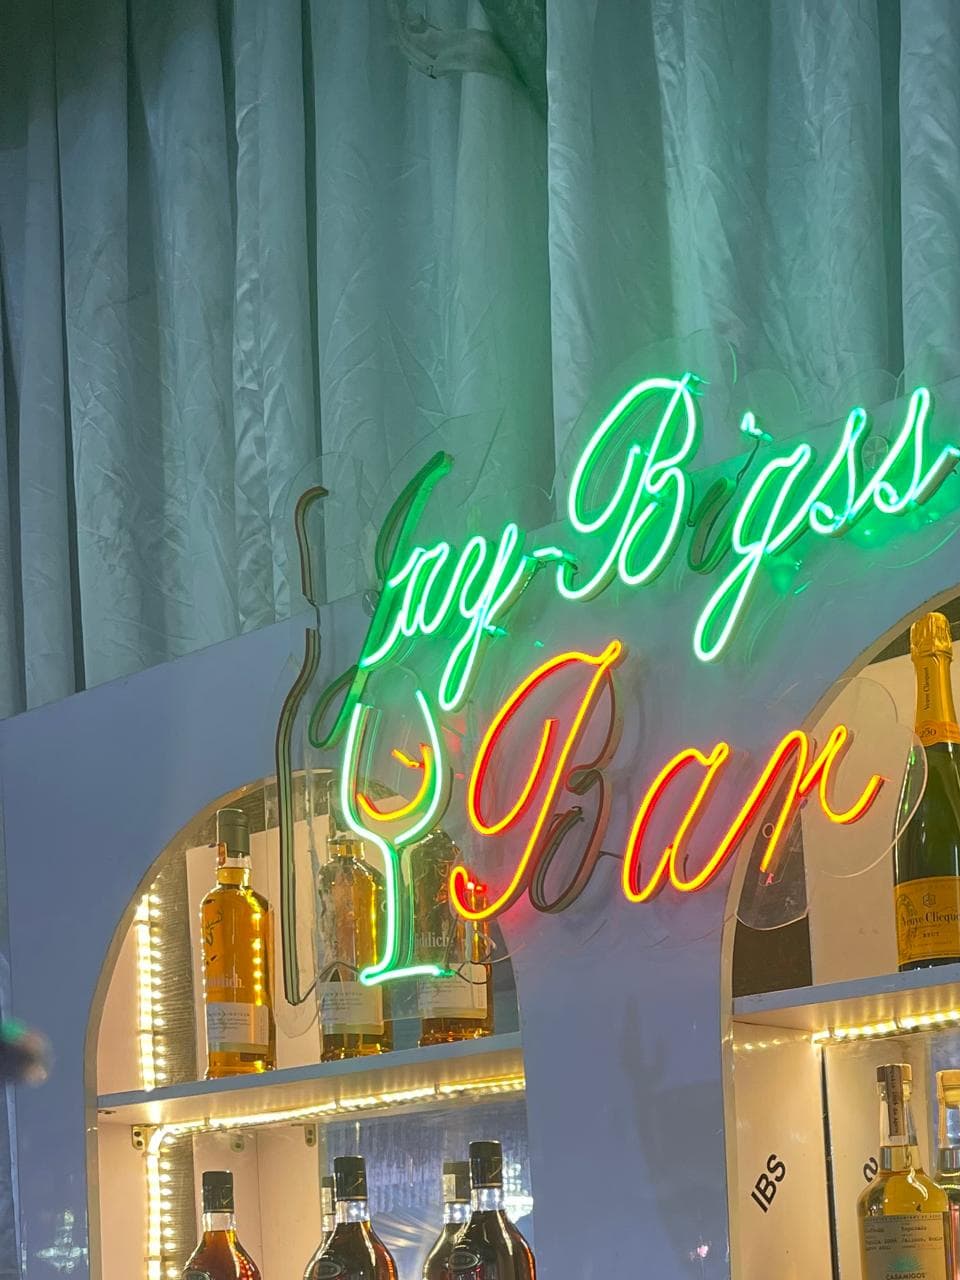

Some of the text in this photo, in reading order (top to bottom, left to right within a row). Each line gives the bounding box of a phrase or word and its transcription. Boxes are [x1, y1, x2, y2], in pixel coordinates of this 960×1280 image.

[449, 640, 885, 920] Bar
[750, 1153, 787, 1213] IBS
[885, 1272, 926, 1280] CASAMIGOS
